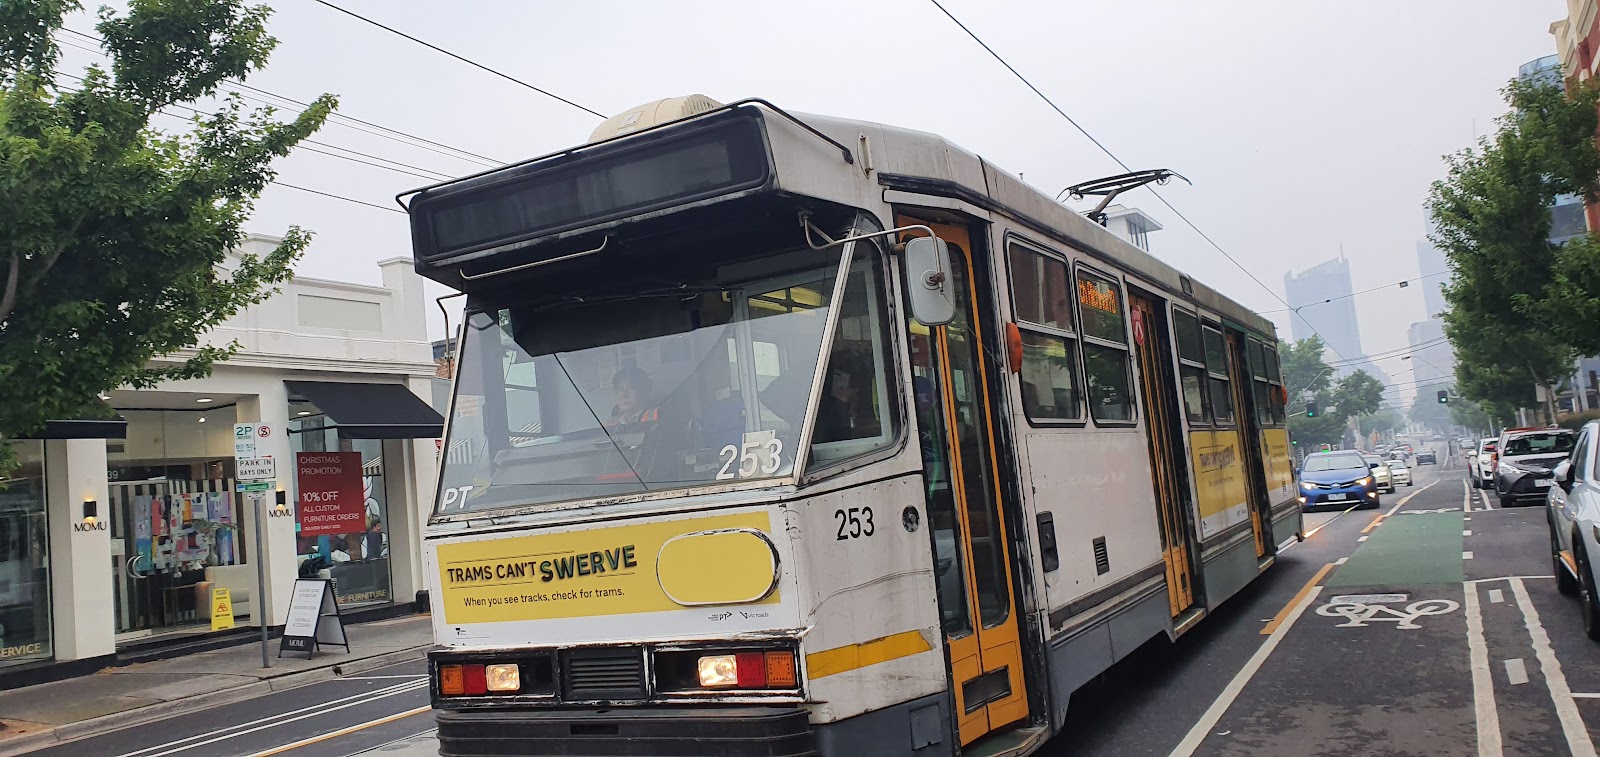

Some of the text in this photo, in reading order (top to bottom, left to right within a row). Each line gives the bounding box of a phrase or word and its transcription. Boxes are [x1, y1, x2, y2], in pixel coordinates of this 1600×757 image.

[236, 426, 253, 436] 2P
[300, 456, 341, 464] CHRISTMAS
[716, 438, 784, 481] 253
[301, 466, 343, 475] PROMOTION
[302, 490, 339, 503] 10% OFF
[441, 485, 474, 512] PT
[268, 508, 294, 518] MOMU
[303, 504, 341, 513] ALL CUSTOM
[303, 512, 360, 523] FURNITURE ORDERS
[834, 506, 875, 541] 253
[74, 521, 108, 532] MOMU
[447, 544, 638, 584] TRAMS CAN'T SWERVE
[348, 589, 387, 602] FURNITURE
[463, 586, 626, 608] When you see tracks, check for trams.
[0, 641, 42, 658] ERVICE
